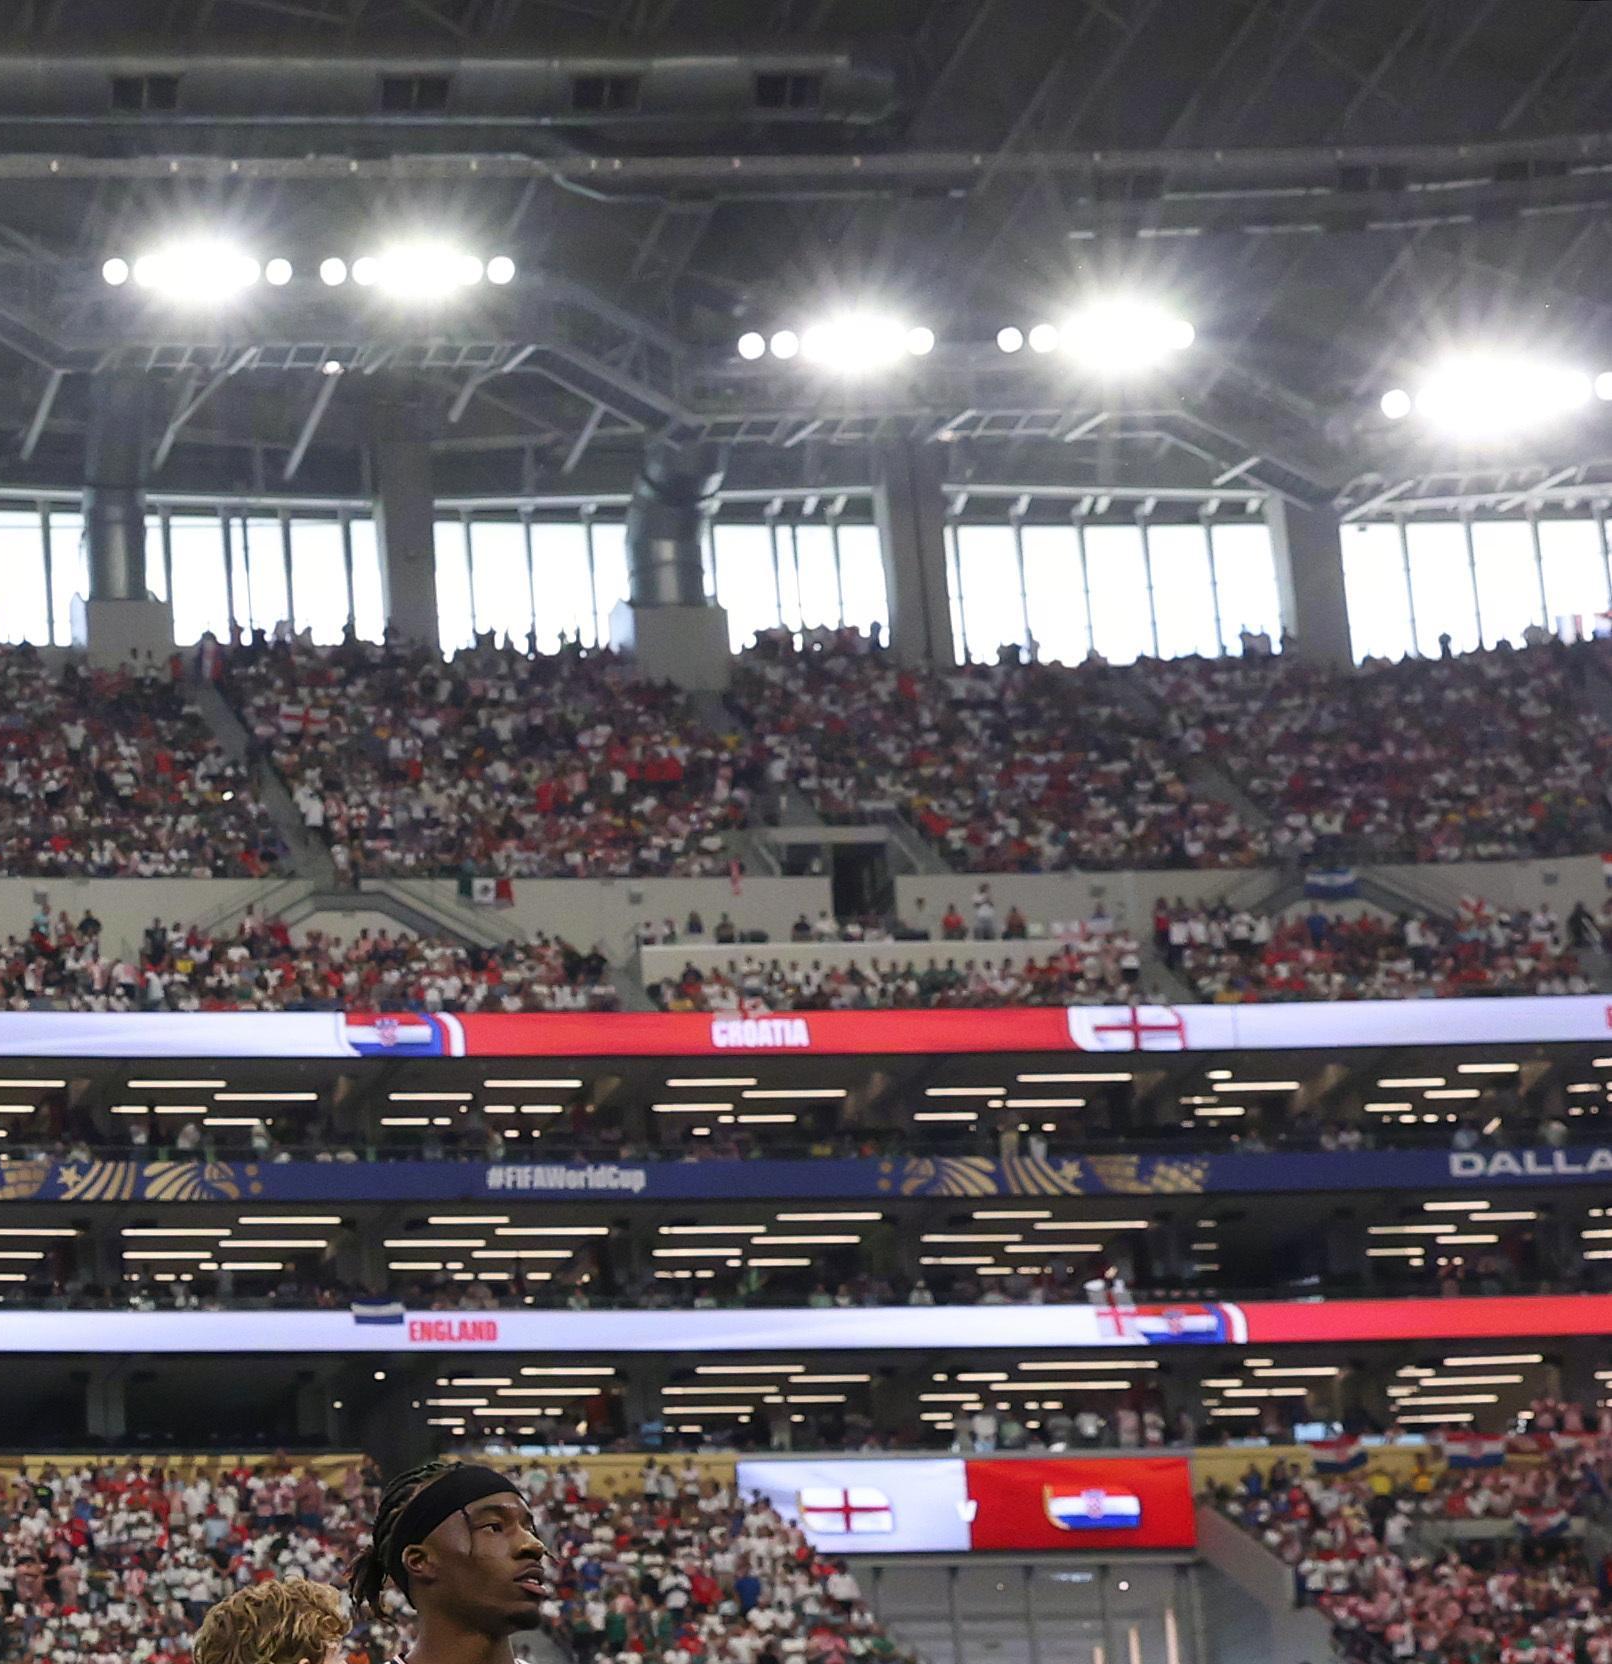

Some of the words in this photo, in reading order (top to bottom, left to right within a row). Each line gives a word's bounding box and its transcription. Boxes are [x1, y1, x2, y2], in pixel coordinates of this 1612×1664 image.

[711, 1018, 810, 1047] CROATIA
[486, 1165, 646, 1193] #FIFAWorldCup
[408, 1320, 499, 1344] ENGLAND
